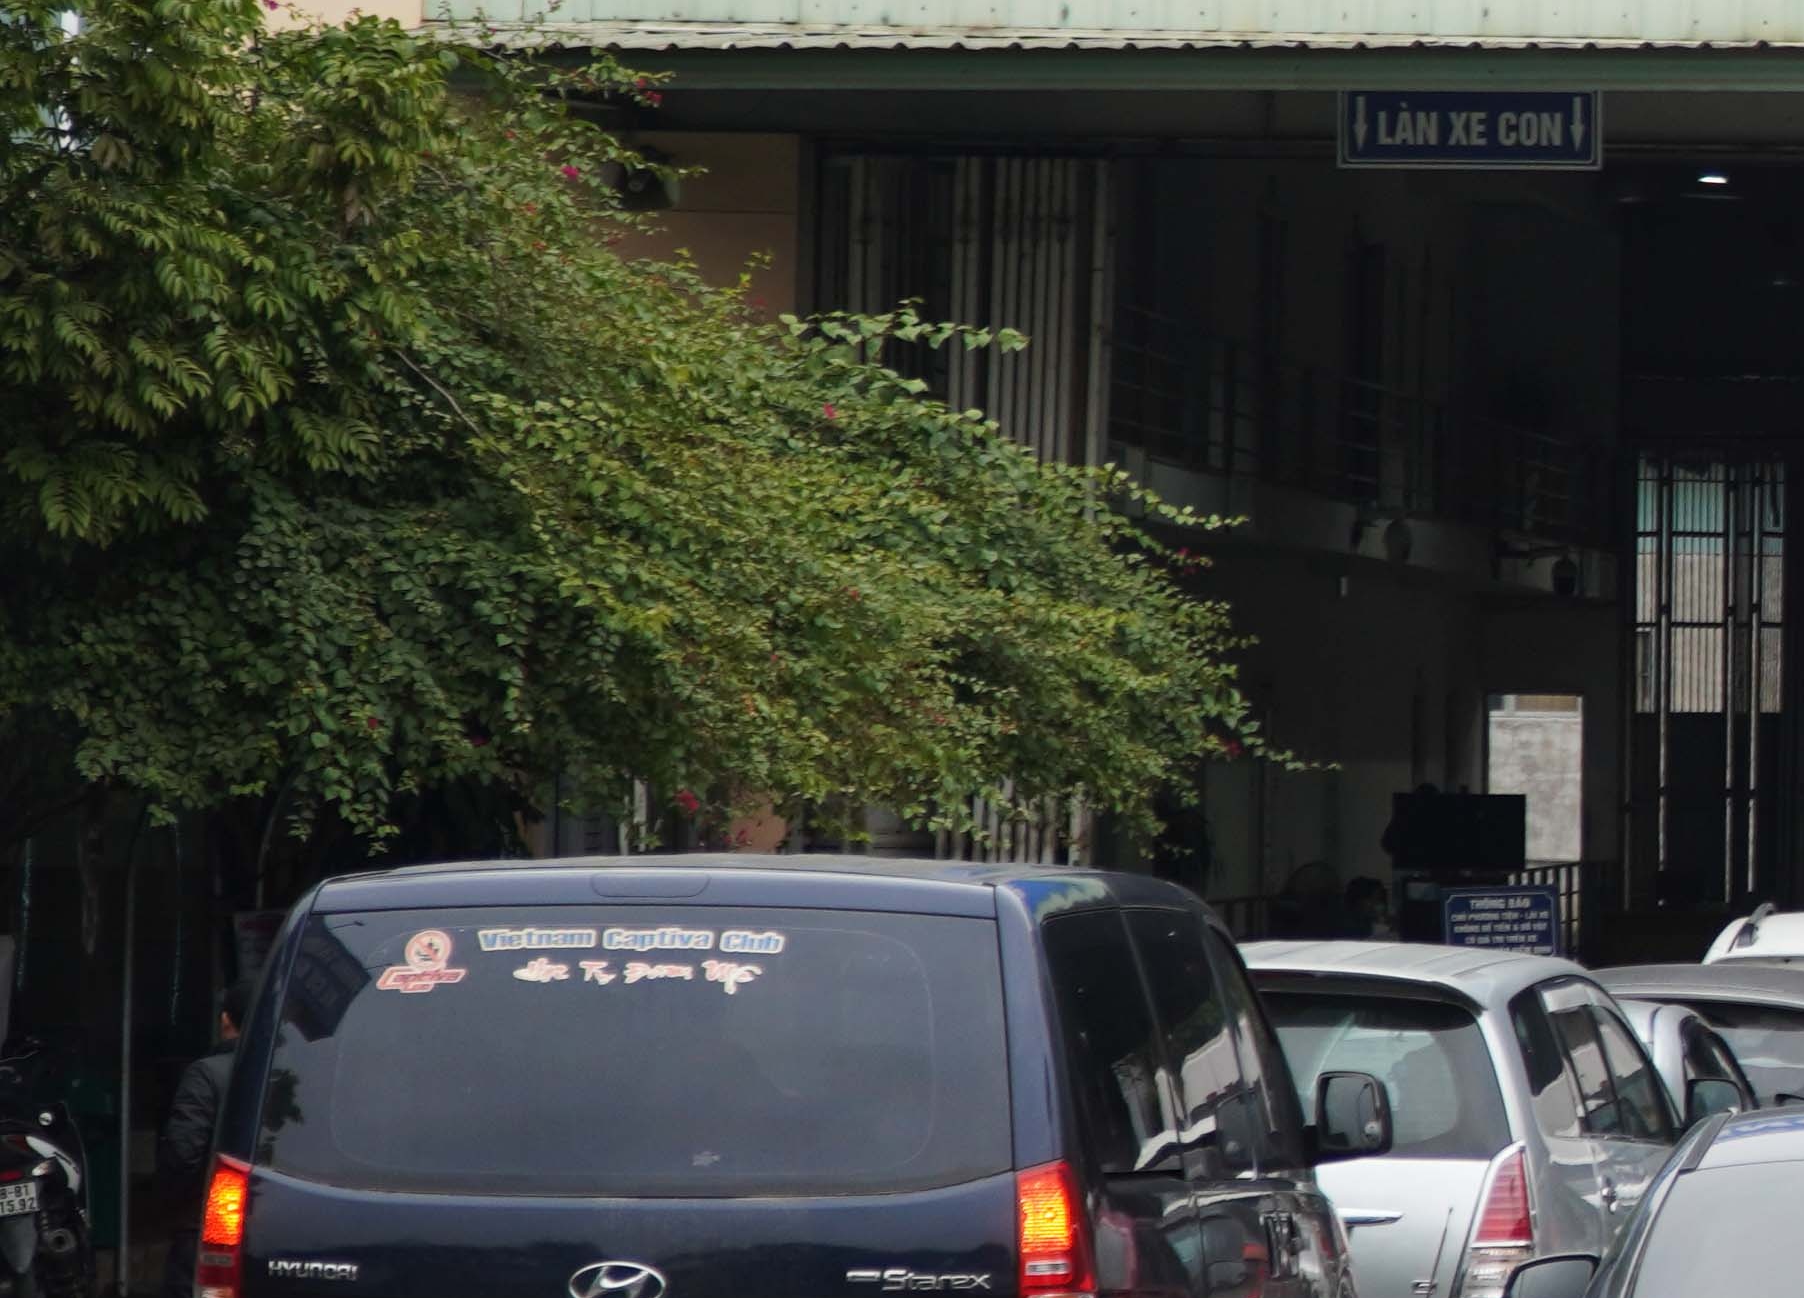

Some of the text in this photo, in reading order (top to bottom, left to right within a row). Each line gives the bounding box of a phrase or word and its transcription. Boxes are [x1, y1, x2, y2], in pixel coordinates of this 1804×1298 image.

[1376, 102, 1562, 147] LÀN XE CON
[480, 929, 783, 952] Vietnam Captiva Club
[268, 1260, 359, 1281] HYUNDAI
[882, 1268, 992, 1291] Starex
